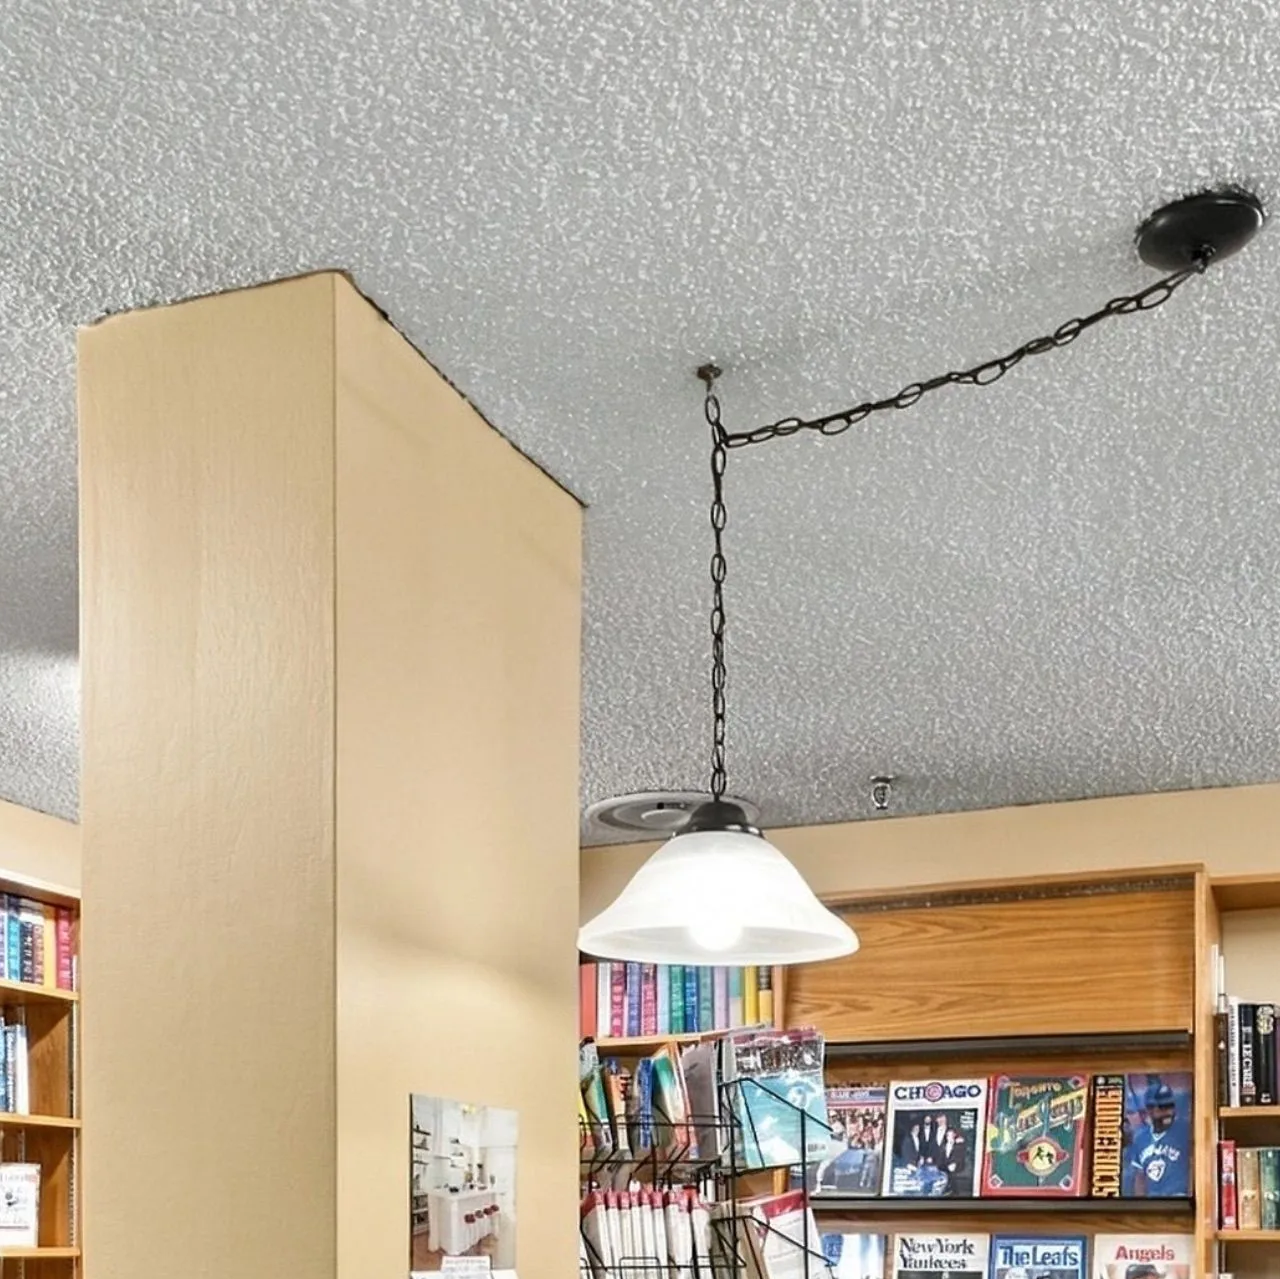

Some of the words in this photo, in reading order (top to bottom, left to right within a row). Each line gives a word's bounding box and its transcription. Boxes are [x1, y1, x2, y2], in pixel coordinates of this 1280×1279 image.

[894, 1081, 982, 1103] CHICAGO
[900, 1238, 934, 1254] New
[935, 1237, 975, 1254] York
[1115, 1245, 1176, 1262] Angels
[900, 1254, 967, 1270] Yankees
[999, 1245, 1030, 1266] The
[1031, 1245, 1079, 1267] Leafs
